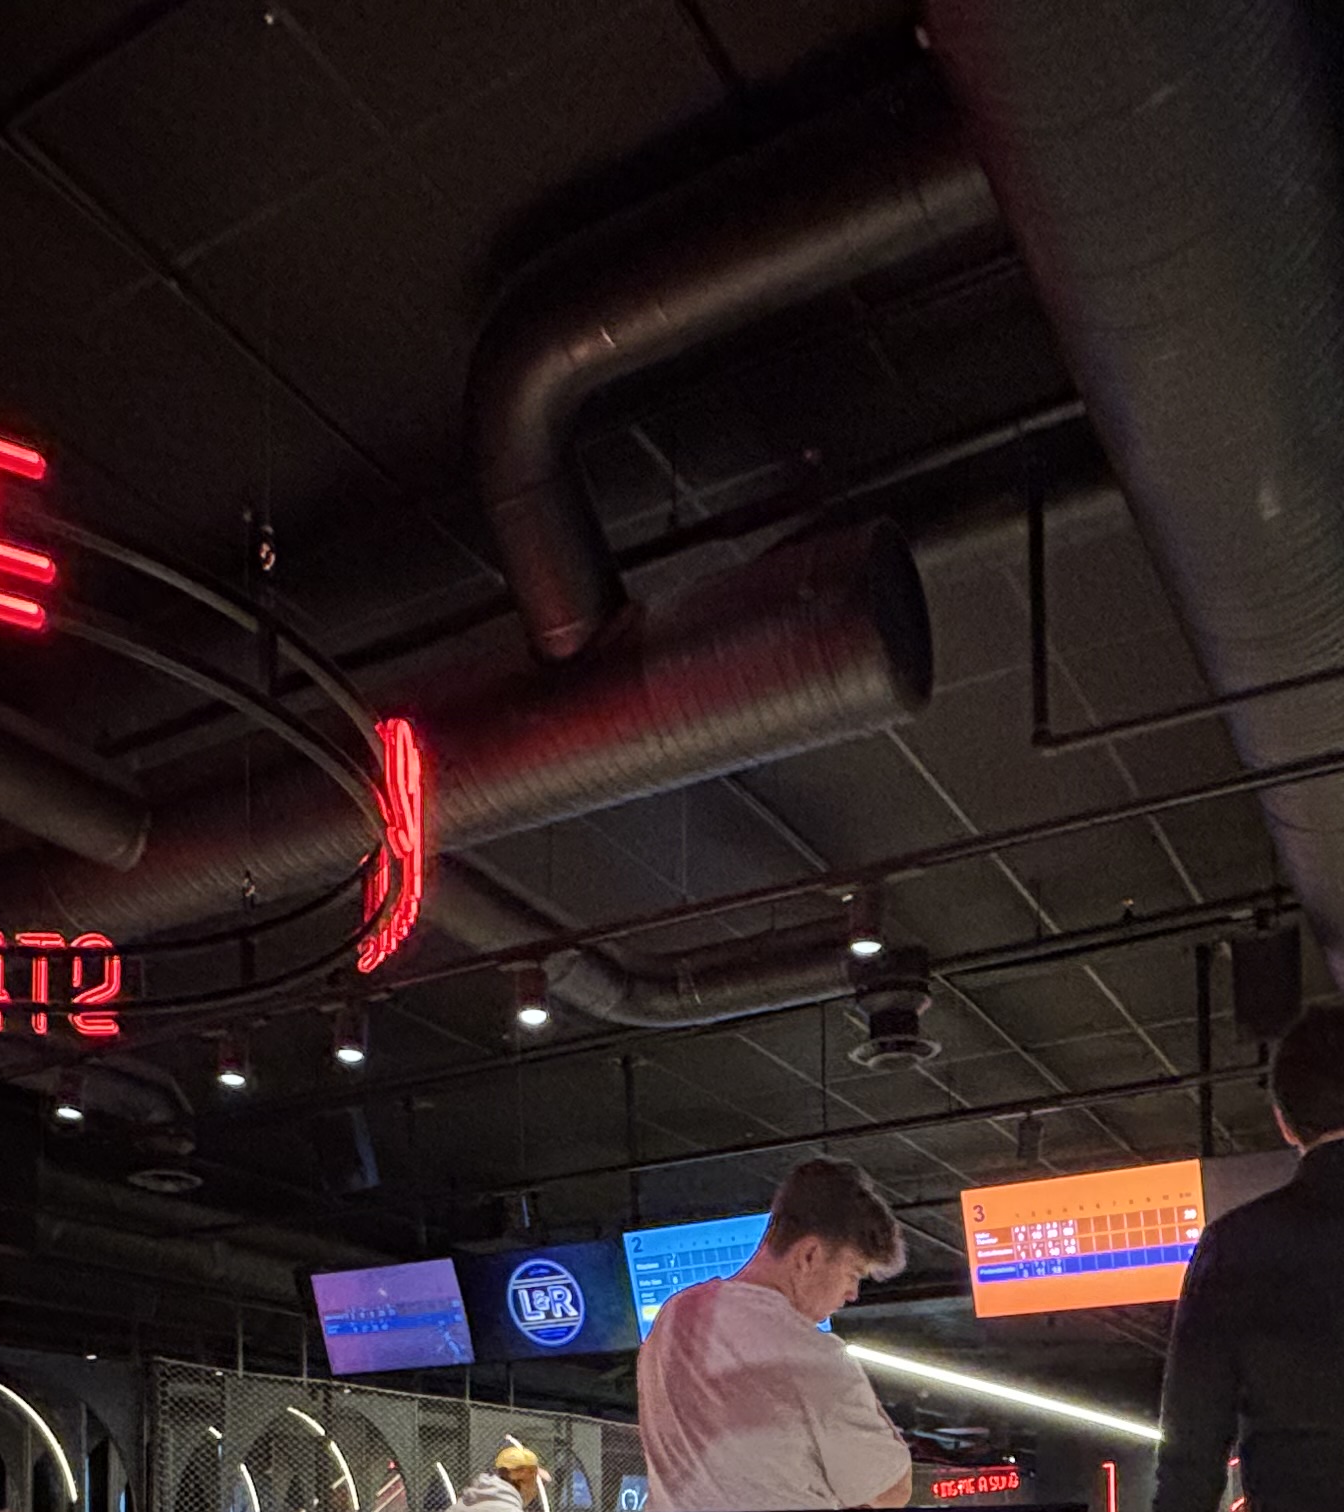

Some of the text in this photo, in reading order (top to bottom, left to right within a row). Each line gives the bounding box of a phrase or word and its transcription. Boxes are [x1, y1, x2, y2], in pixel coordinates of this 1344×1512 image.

[973, 1204, 985, 1223] 3
[631, 1236, 643, 1253] 2
[518, 1285, 579, 1321] L&R
